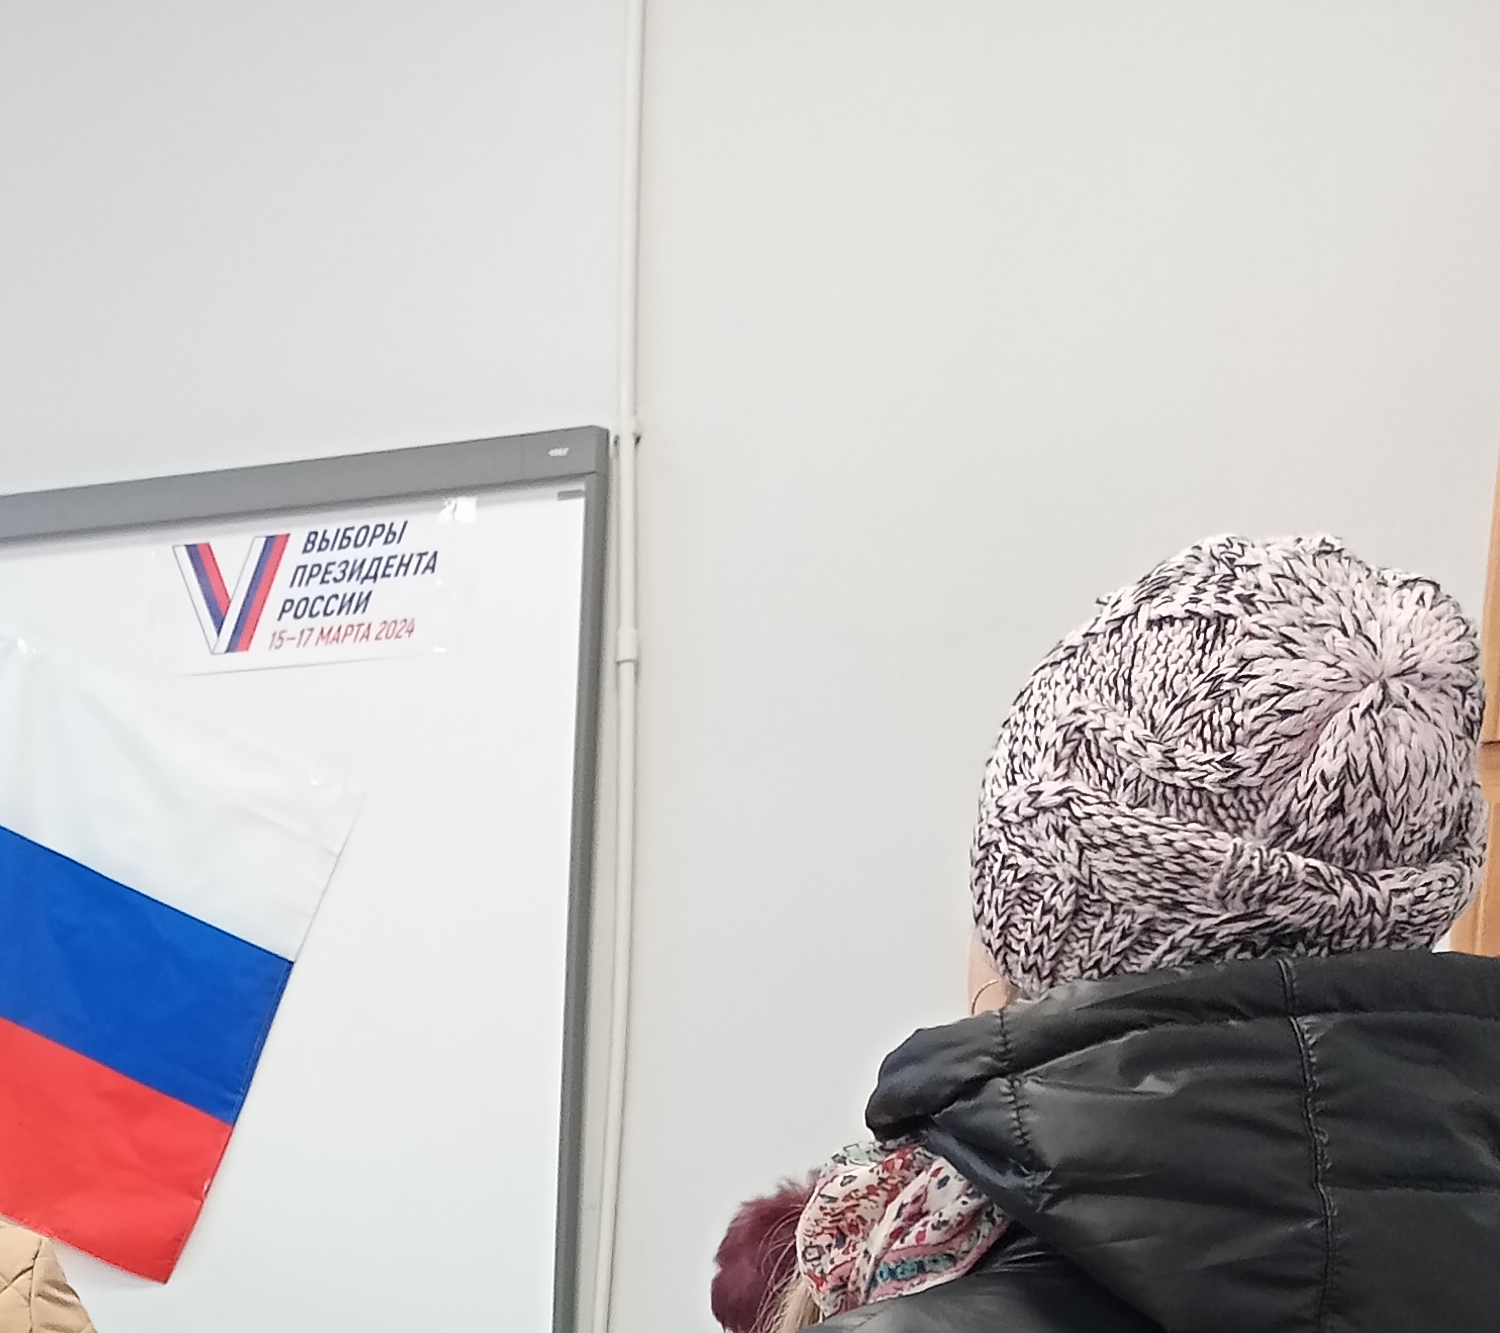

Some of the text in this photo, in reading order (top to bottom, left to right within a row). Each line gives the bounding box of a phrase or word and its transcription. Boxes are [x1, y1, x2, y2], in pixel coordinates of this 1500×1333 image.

[301, 520, 409, 554] ВЫБОРЫ
[289, 550, 438, 588] ПРЕЗИДЕНТА
[276, 590, 373, 622] РОССИИ
[315, 621, 372, 647] МАРТА
[374, 617, 415, 642] 2024
